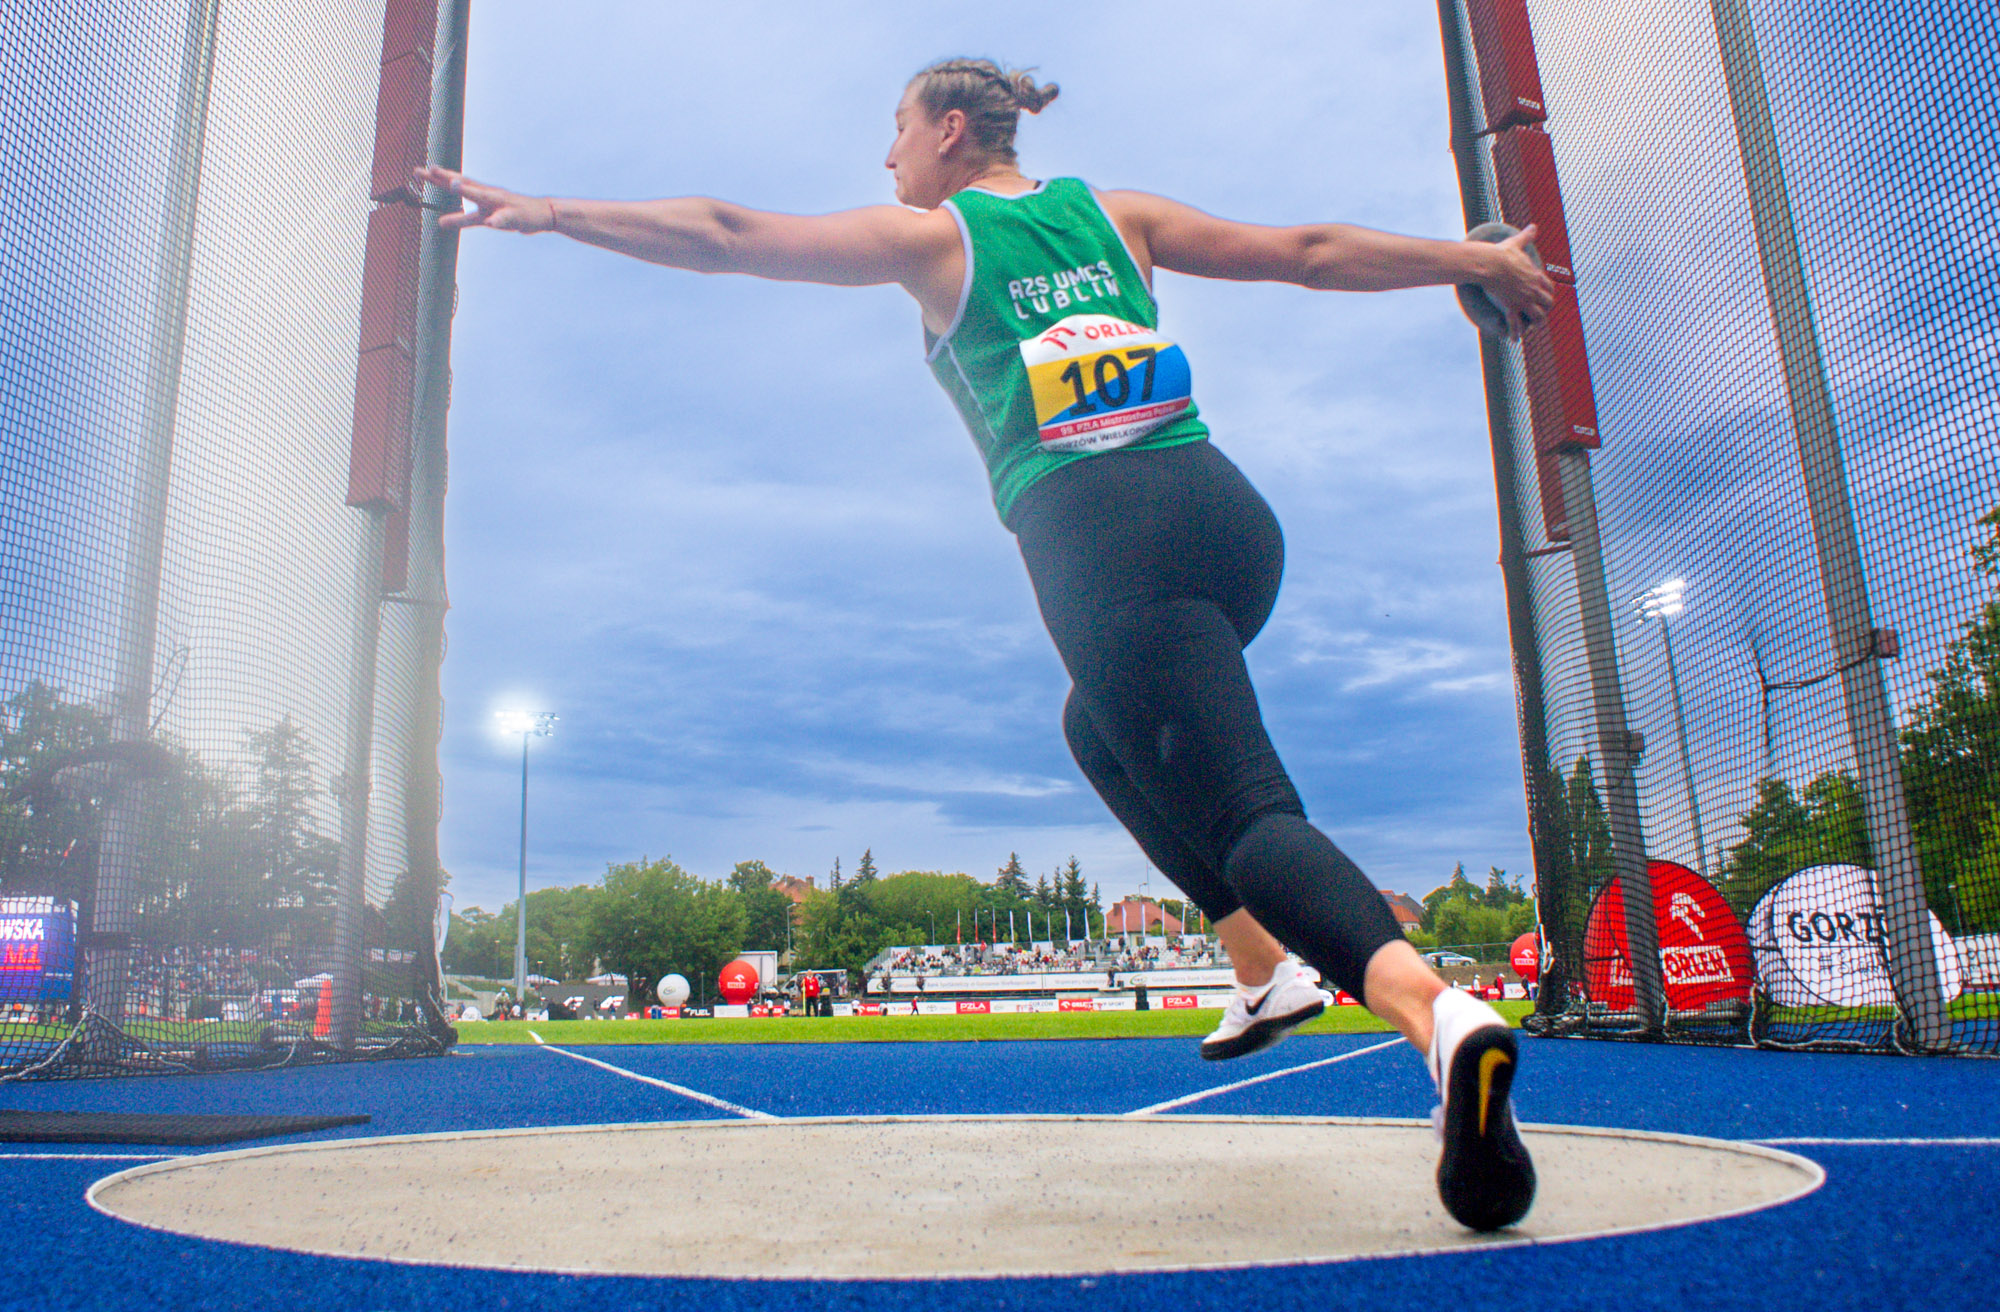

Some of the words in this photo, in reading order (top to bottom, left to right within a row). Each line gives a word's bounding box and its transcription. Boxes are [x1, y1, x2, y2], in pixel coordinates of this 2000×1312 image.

[1008, 275, 1050, 300] AZS
[1053, 260, 1114, 290] UMCS
[1013, 277, 1121, 320] LUBLIN
[1060, 347, 1157, 417] 107
[1788, 908, 1887, 942] GORZ
[1663, 950, 1725, 979] ORLEN
[690, 1008, 711, 1017] FUEL
[960, 1002, 986, 1010] PZLA
[1167, 997, 1193, 1006] PZLA
